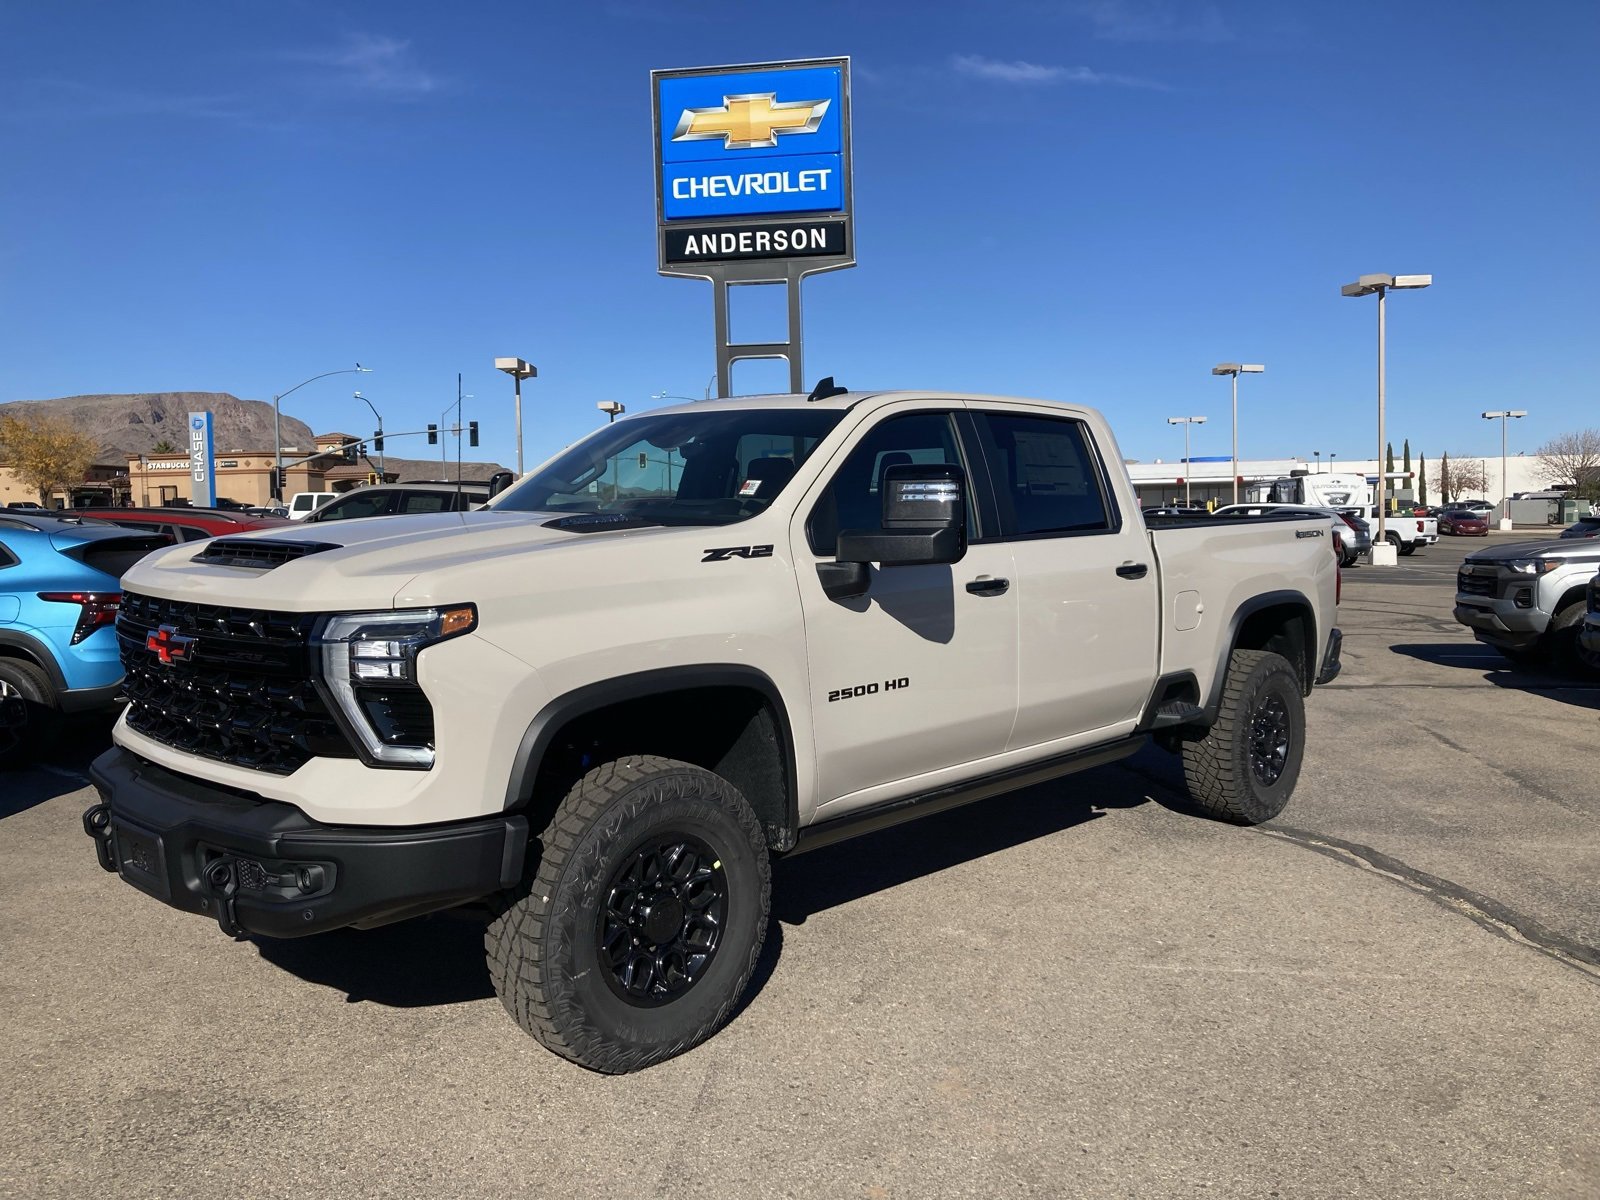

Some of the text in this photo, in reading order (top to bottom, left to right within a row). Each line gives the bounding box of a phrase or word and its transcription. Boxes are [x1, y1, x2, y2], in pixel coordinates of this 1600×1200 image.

[672, 169, 831, 199] CHEVROLET
[684, 228, 827, 255] ANDERSON
[147, 461, 190, 471] STARBUCKS
[193, 432, 205, 482] CHASE
[1298, 529, 1324, 538] BISON
[701, 544, 774, 562] ZR2
[828, 677, 910, 703] 2500 HD
